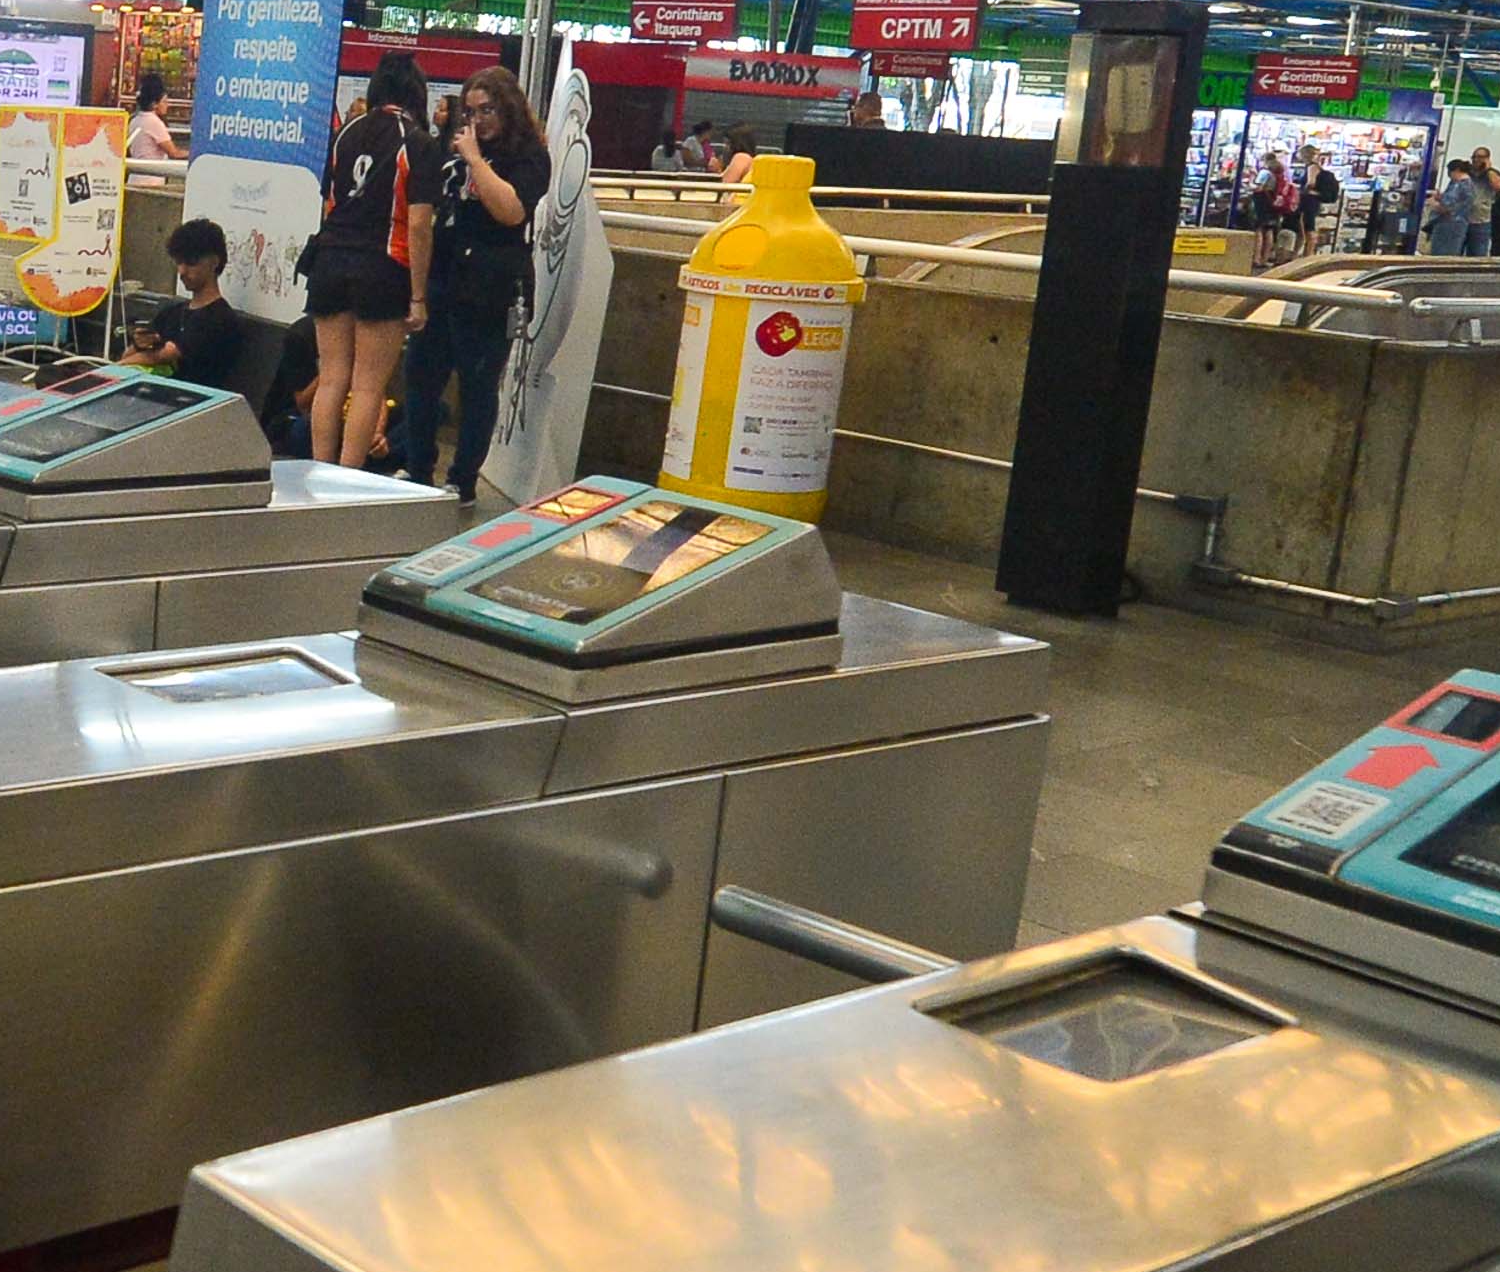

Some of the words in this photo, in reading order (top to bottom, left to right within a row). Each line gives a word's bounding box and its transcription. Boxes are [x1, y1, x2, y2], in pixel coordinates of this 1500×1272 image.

[656, 7, 724, 22] Corinthians
[655, 23, 702, 38] Itaquera
[881, 17, 942, 39] CPTM
[233, 35, 297, 66] respeite
[1279, 71, 1347, 85] Corinthians
[13, 89, 38, 99] 24H
[216, 79, 226, 96] o
[229, 74, 309, 108] embarque
[1279, 82, 1325, 96] Itaquera
[209, 111, 305, 144] preferencial.
[348, 154, 374, 197] 9
